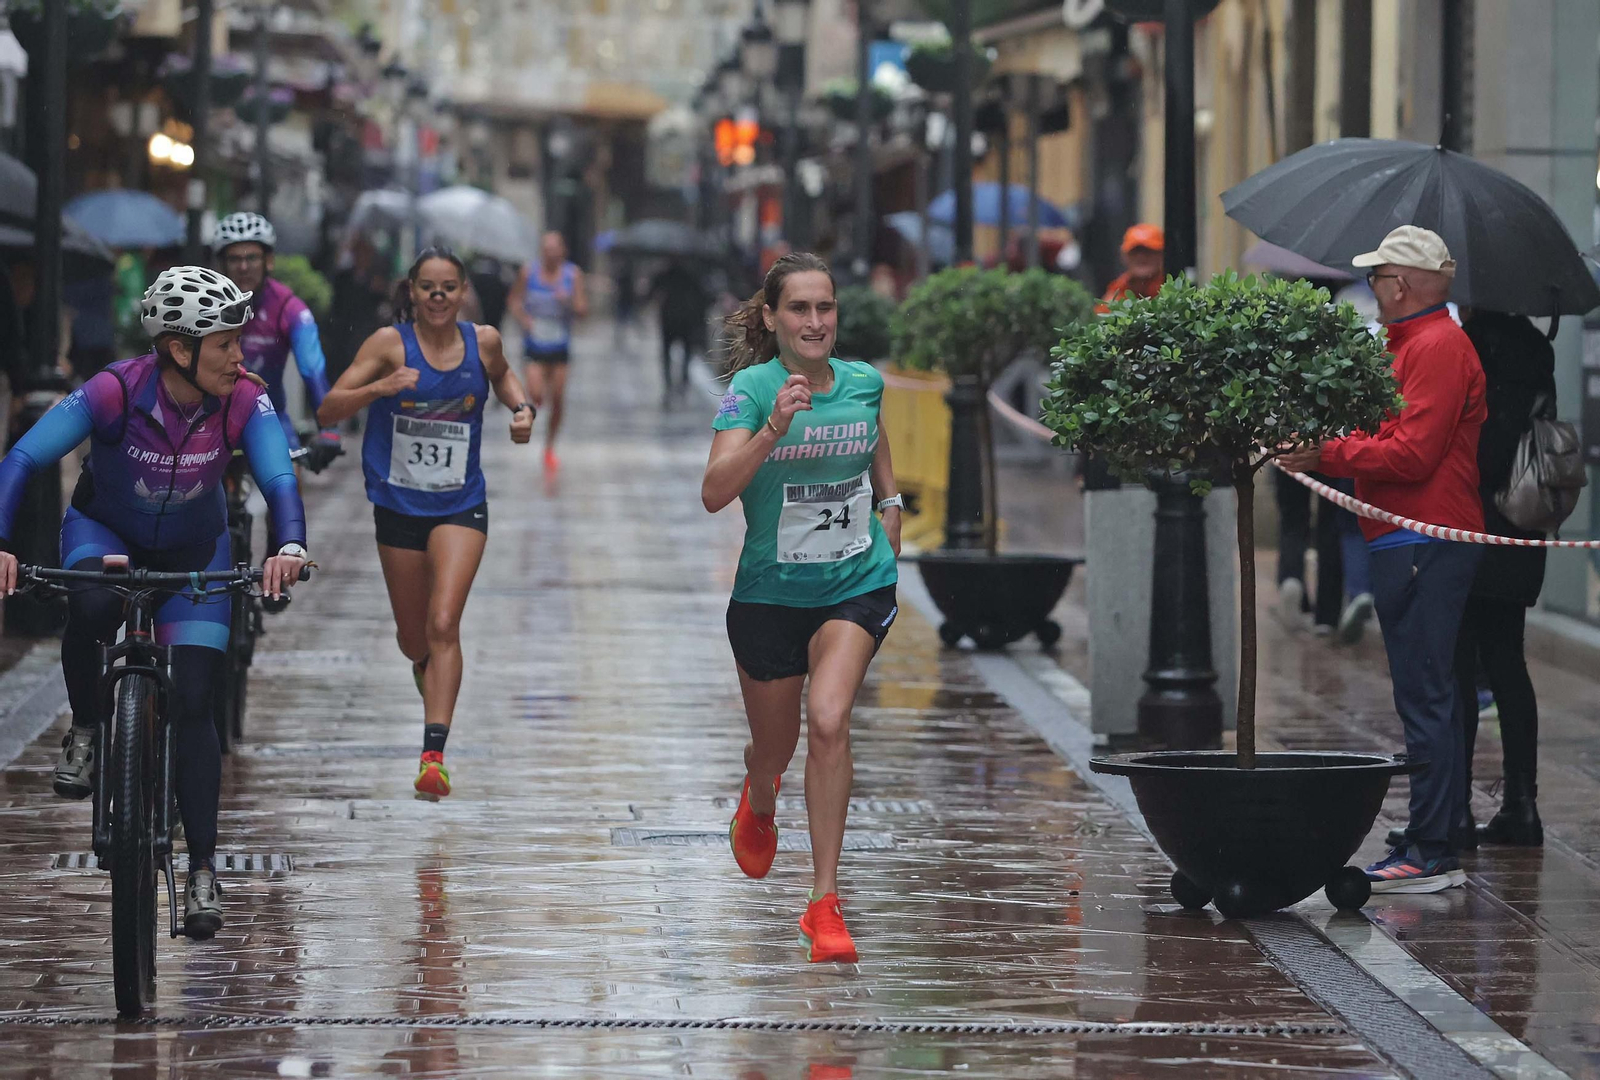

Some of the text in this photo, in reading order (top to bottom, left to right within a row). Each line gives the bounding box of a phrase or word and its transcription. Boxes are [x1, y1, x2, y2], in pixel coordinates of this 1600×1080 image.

[163, 323, 202, 336] catlike
[803, 421, 868, 441] MEDIA
[139, 450, 160, 464] MTB
[408, 442, 452, 468] 331
[764, 437, 868, 462] MARATÓN
[814, 504, 850, 531] 24
